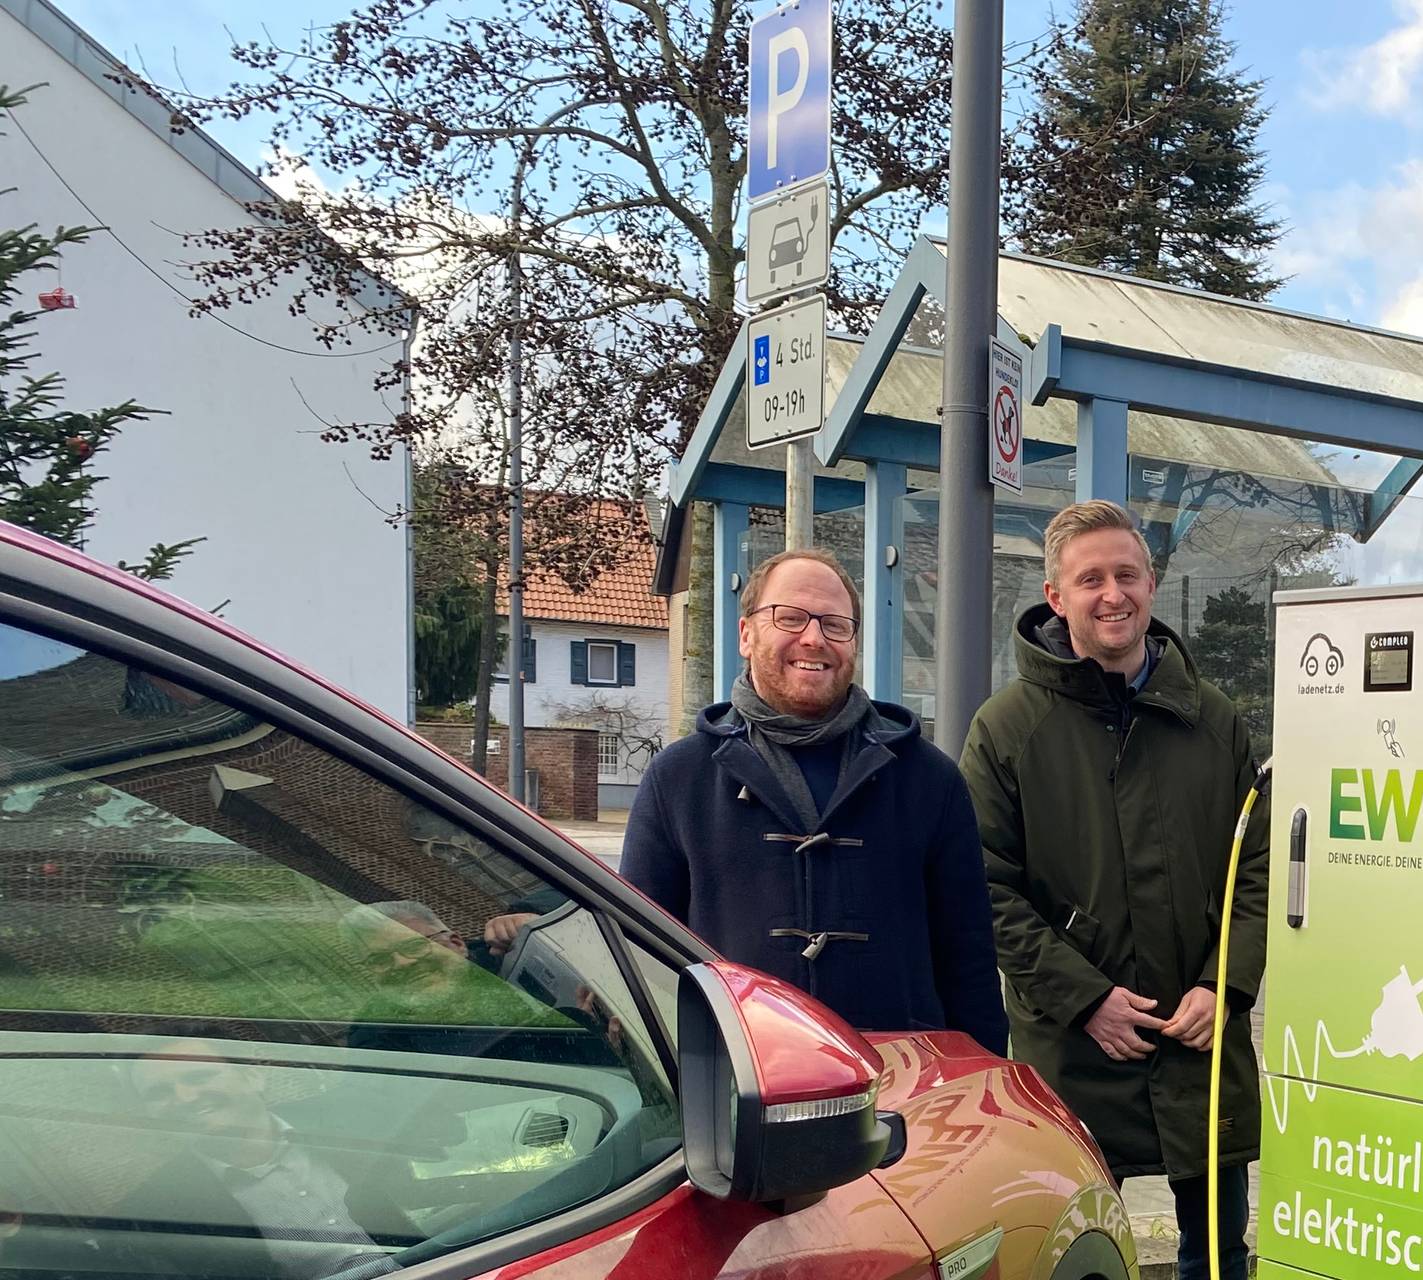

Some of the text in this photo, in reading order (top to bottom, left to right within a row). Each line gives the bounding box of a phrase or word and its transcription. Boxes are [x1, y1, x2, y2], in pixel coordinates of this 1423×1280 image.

[767, 26, 809, 169] P
[776, 333, 815, 367] 4 Std.
[764, 388, 805, 422] 09-19h
[1379, 636, 1408, 647] COMPLEO
[1298, 683, 1344, 695] ladenetz.de
[1328, 852, 1352, 865] DEINE
[1355, 854, 1393, 867] ENERGIE.
[1395, 856, 1422, 869] DEINE
[947, 1257, 967, 1278] PRO
